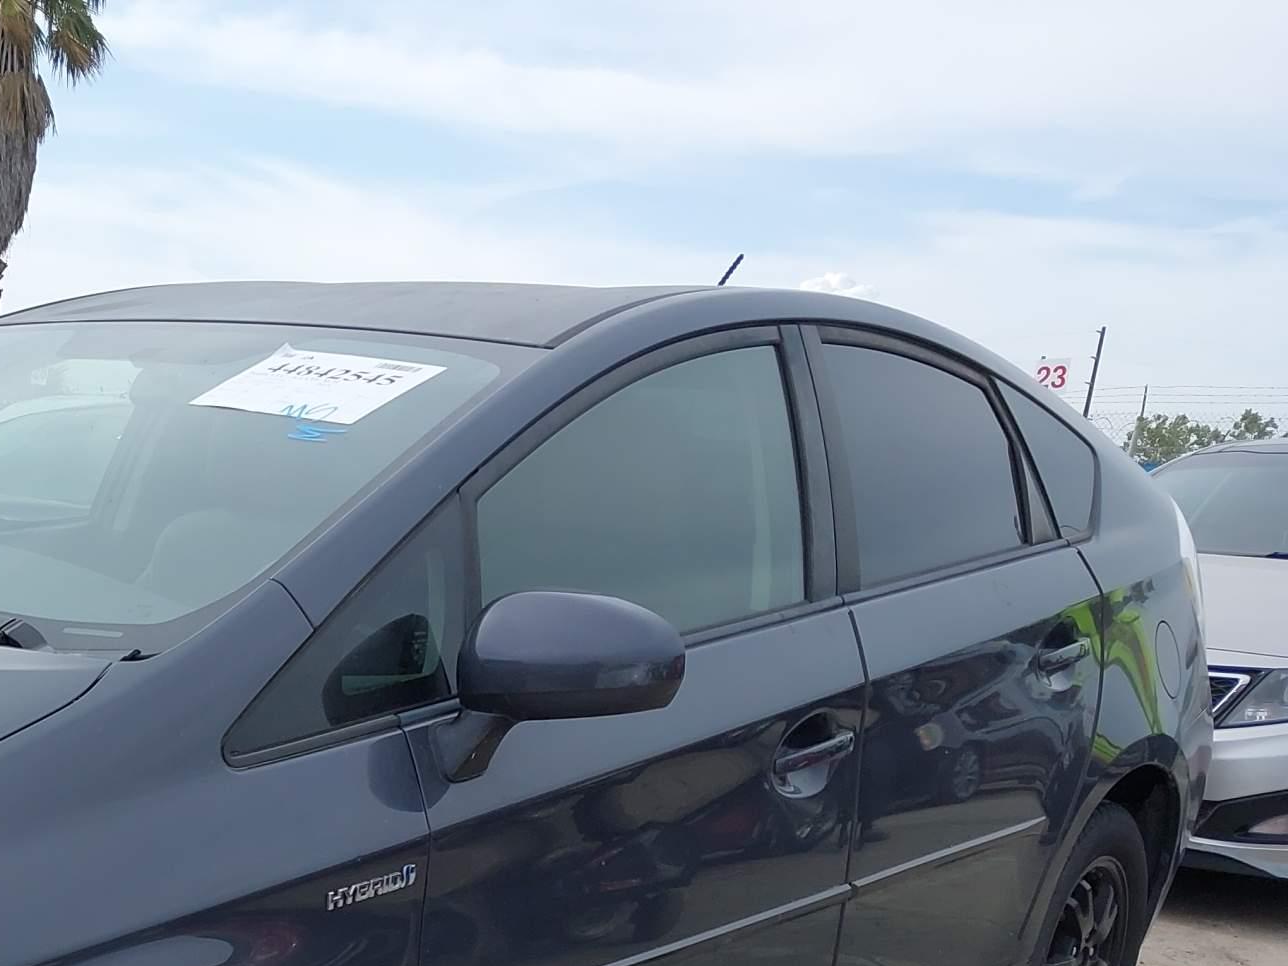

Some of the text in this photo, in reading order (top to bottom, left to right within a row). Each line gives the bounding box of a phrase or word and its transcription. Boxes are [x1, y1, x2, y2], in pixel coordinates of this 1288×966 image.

[267, 362, 404, 386] 44842545
[1036, 364, 1067, 389] 23
[326, 871, 404, 911] HYBRID
